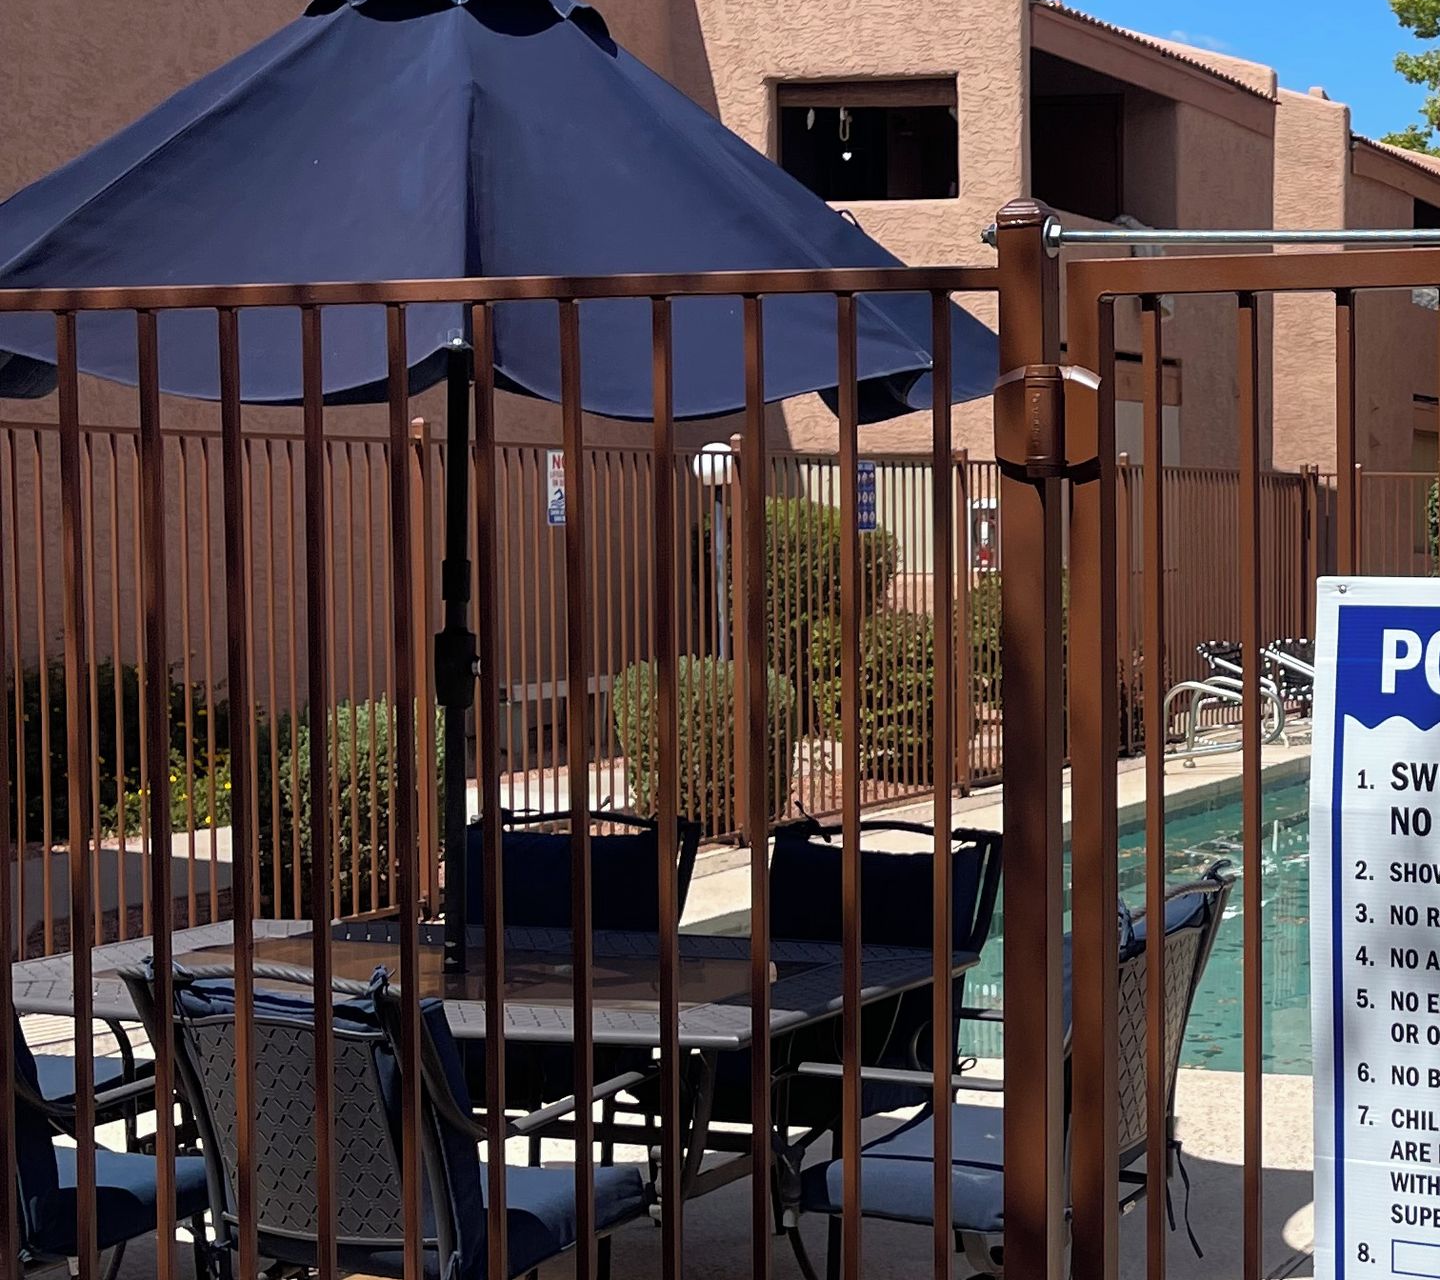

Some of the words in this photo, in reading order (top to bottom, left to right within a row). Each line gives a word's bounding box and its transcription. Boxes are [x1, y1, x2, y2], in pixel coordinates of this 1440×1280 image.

[1358, 770, 1374, 789] 1.
[1391, 807, 1431, 836] NO
[1355, 861, 1373, 880] 2.
[1355, 903, 1374, 923] 3.
[1391, 905, 1418, 926] NO
[1356, 946, 1374, 966] 4.
[1391, 948, 1418, 969] NO
[1356, 989, 1374, 1008] 5.
[1391, 991, 1419, 1012] NO
[1391, 1023, 1419, 1044] OR
[1358, 1062, 1375, 1083] 6.
[1392, 1065, 1419, 1086] NO
[1358, 1105, 1373, 1125] 7.
[1391, 1140, 1431, 1163] ARE
[1358, 1243, 1375, 1263] 8.
